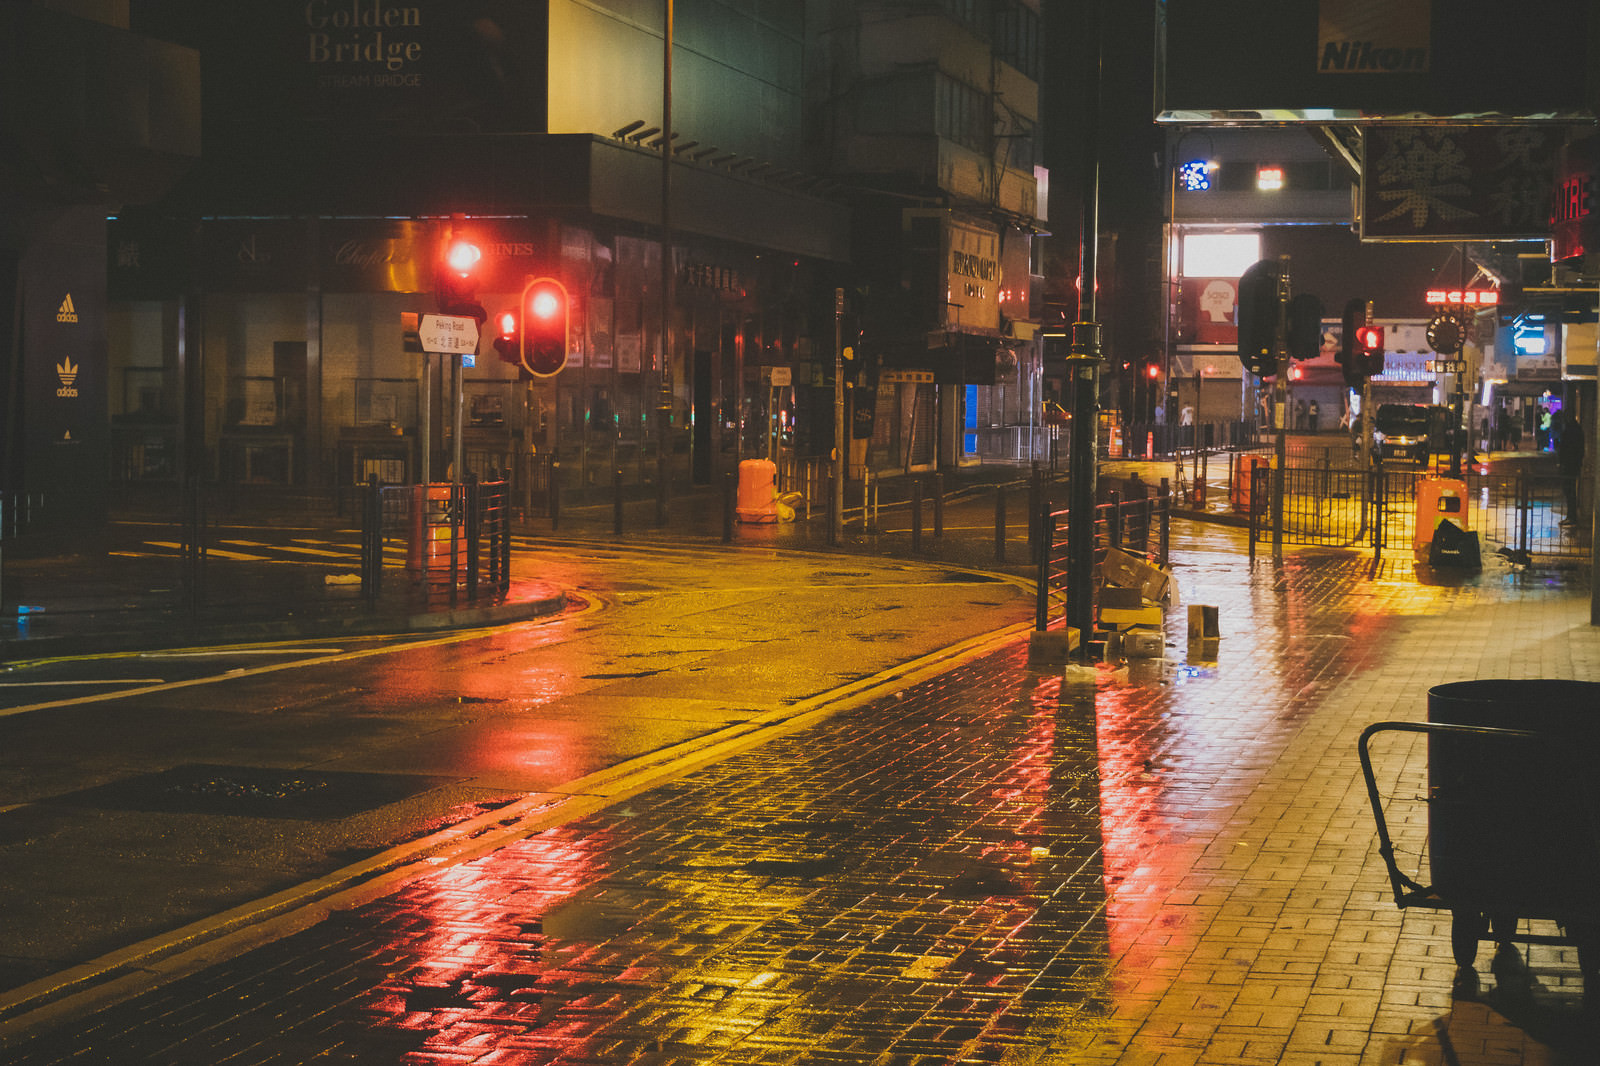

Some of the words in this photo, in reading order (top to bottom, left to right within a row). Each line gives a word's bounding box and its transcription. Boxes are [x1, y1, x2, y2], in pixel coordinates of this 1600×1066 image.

[305, 0, 422, 28] Golden
[306, 31, 422, 71] Bridge
[1320, 41, 1427, 71] Nikon
[319, 73, 370, 87] STREAM
[374, 72, 423, 87] BRIDGE
[56, 312, 79, 324] adidas
[435, 319, 452, 332] Peking
[452, 320, 465, 332] Road
[56, 386, 79, 398] adidas
